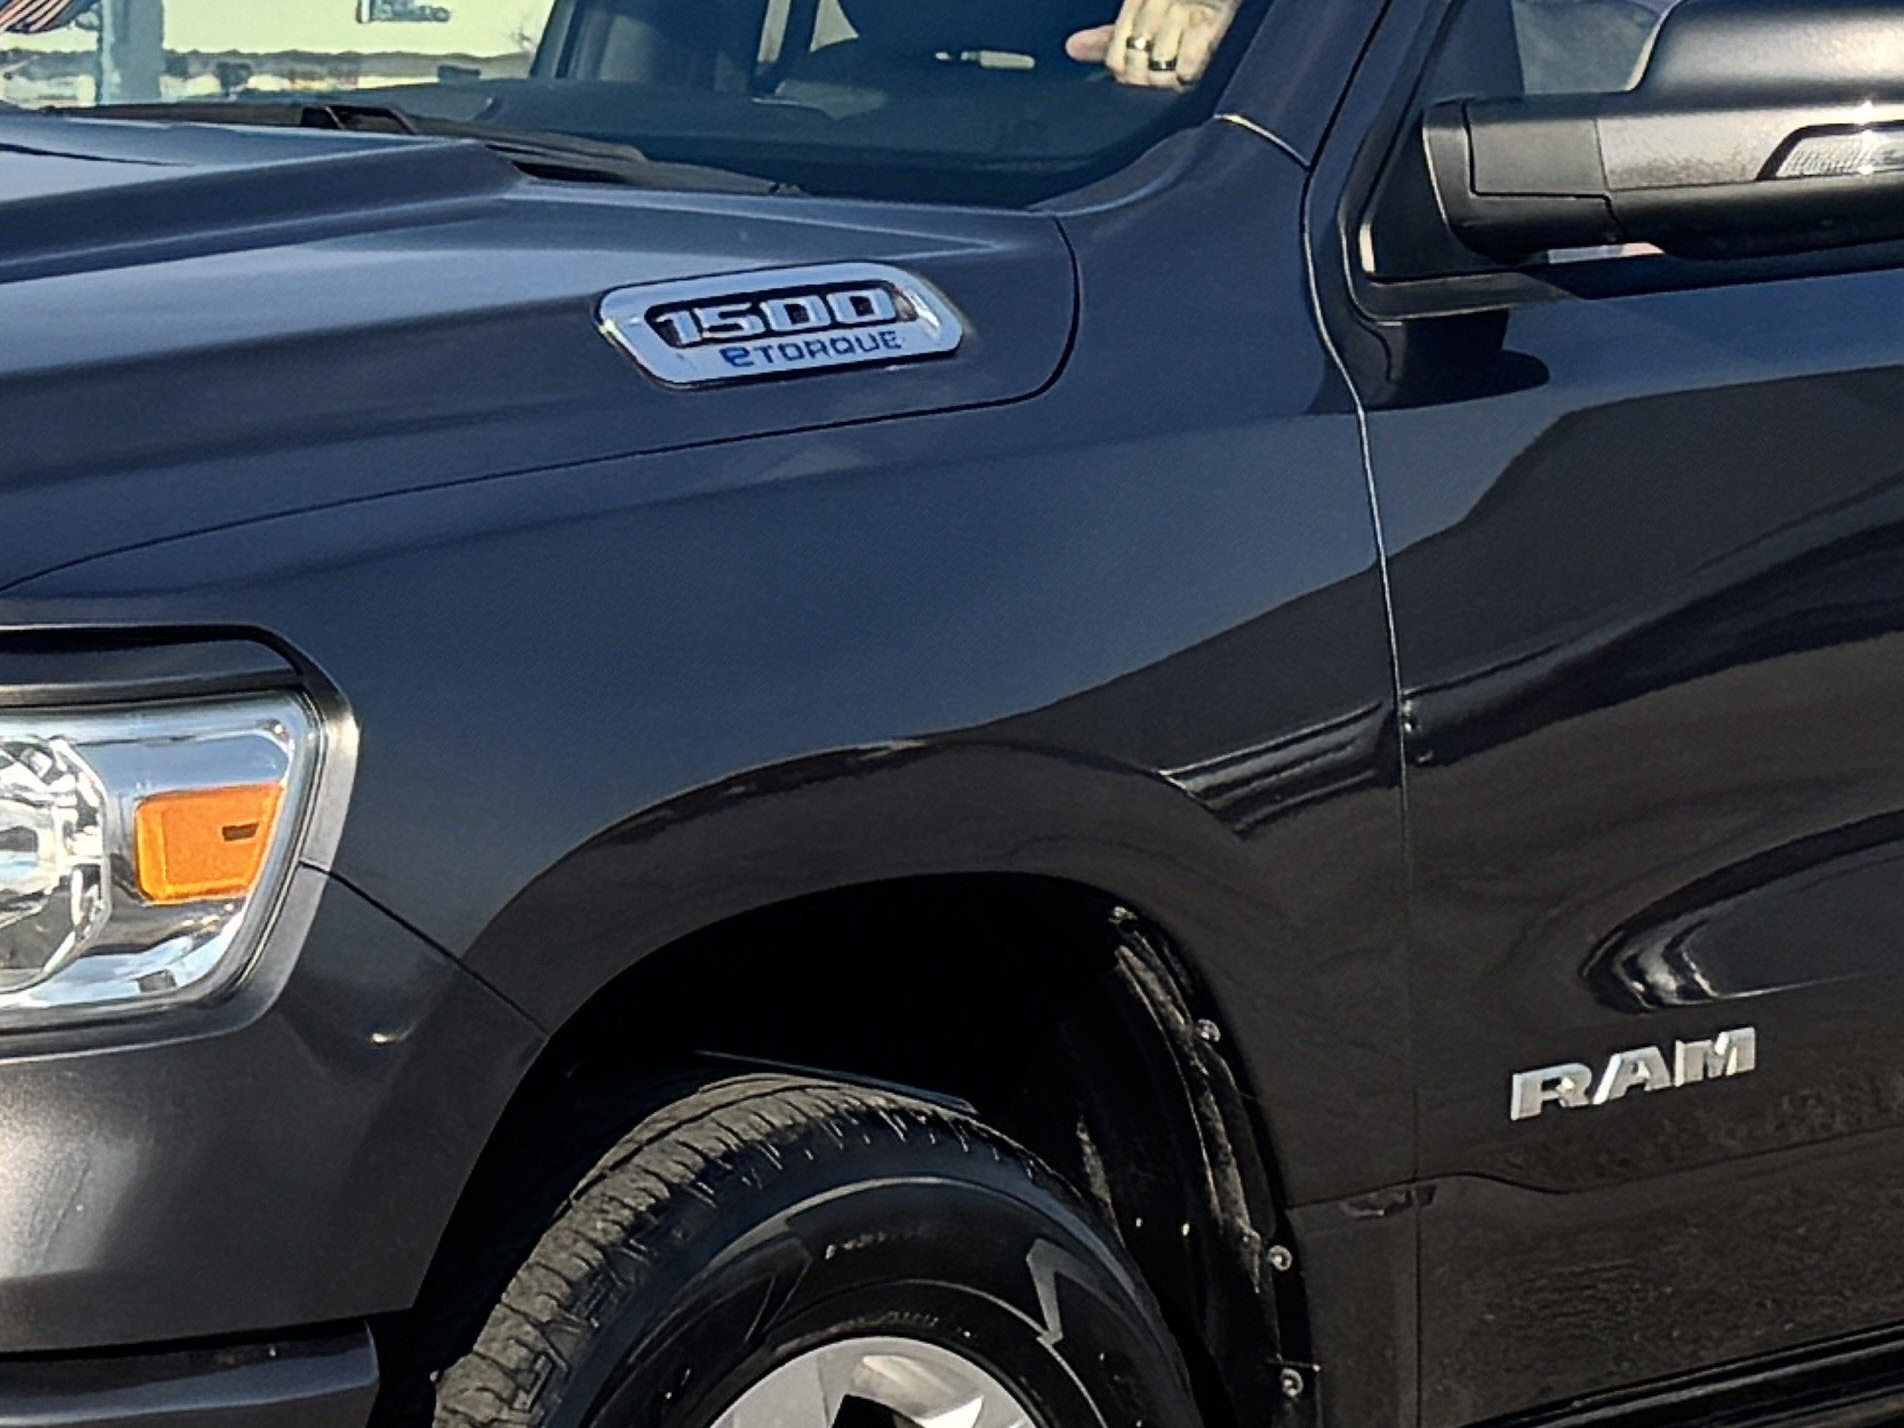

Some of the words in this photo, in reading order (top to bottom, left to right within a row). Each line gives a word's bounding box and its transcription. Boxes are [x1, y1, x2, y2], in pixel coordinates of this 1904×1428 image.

[656, 287, 898, 346] 1500
[720, 331, 902, 369] eTORQUE
[1509, 1026, 1756, 1122] RAM
